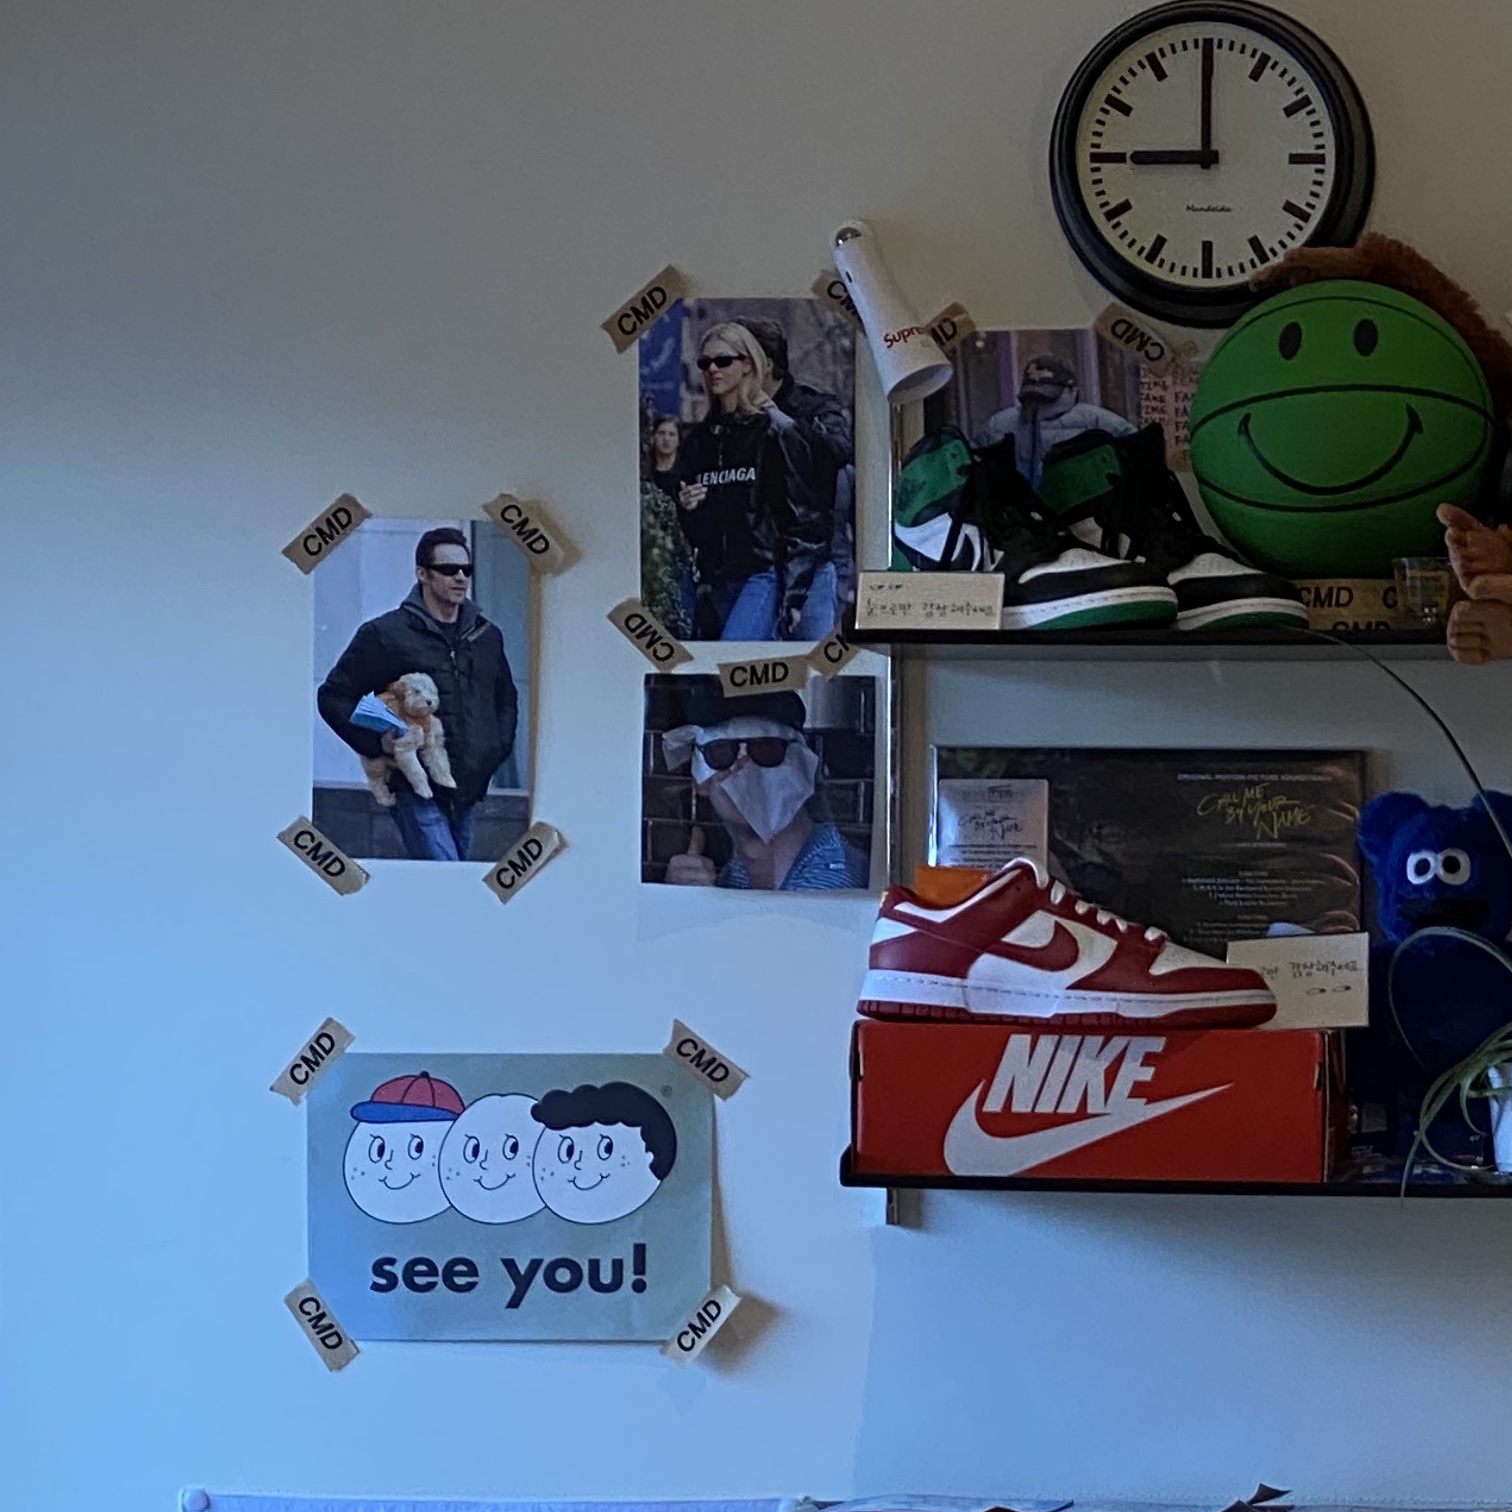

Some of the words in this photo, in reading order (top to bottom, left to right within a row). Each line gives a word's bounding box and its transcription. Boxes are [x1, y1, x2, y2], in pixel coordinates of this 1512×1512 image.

[616, 285, 668, 339] CMD
[1111, 318, 1165, 361] CMD
[301, 505, 354, 560] CMD
[499, 503, 551, 559] CMD
[623, 611, 675, 663] CMD
[729, 661, 790, 688] CMD
[292, 829, 346, 878] CMD
[494, 836, 545, 891] CMD
[288, 1031, 337, 1087] CMD
[674, 1037, 731, 1085] CMD
[982, 1034, 1167, 1114] NIKE
[370, 1257, 479, 1293] see
[500, 1243, 648, 1309] you!
[298, 1295, 343, 1351] CMD
[675, 1299, 723, 1353] CMD
